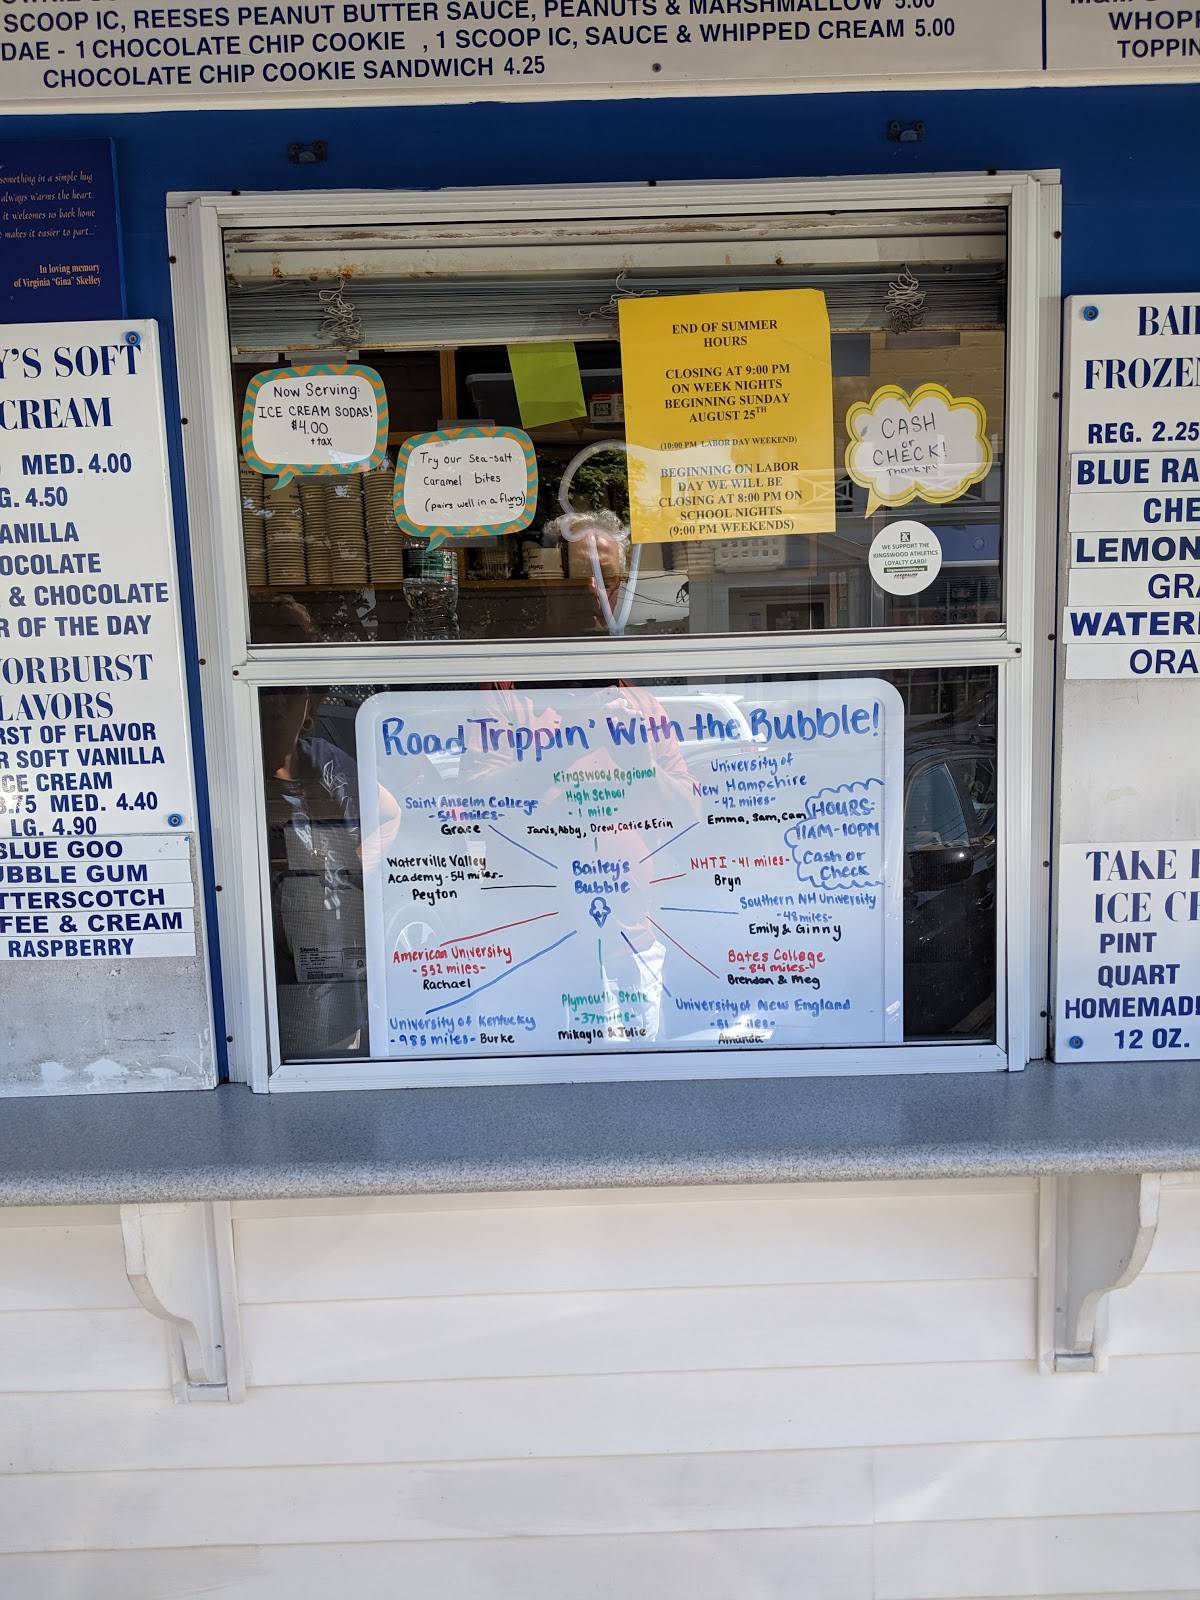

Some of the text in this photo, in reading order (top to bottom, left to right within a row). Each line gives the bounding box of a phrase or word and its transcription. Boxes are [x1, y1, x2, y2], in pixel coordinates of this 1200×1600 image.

[4, 0, 536, 33] SCOOP IC, REESES PEANUT BUTTER SAUCE,
[700, 17, 955, 42] WHIPPED CREAM 5.00
[43, 55, 545, 89] CHOCOLATE CHIP COOKIE SANDWICH 4.25
[12, 209, 46, 220] welcomes
[59, 208, 75, 218] back
[77, 207, 96, 218] home
[39, 264, 100, 274] In loving memory
[14, 278, 21, 288] of
[23, 278, 50, 289] Virginia
[76, 276, 101, 287] Skelley
[672, 319, 778, 335] END OF SUMMER
[704, 336, 748, 348] HOURS
[54, 345, 141, 378] SOFT
[665, 363, 790, 379] CLOSING AT 9:00 PM
[273, 385, 300, 399] Now
[671, 379, 783, 394] ON WEEK NIGHTS
[665, 393, 791, 409] BEGINNING SUNDAY
[257, 406, 283, 419] ICE
[689, 411, 740, 423] AUGUST
[291, 420, 329, 435] $4.00
[1087, 422, 1143, 444] REG.
[22, 452, 132, 475] MED. 4.00
[419, 451, 439, 470] Try
[756, 461, 799, 473] LABOR
[474, 471, 501, 484] bites
[1077, 458, 1150, 485] BLUE
[25, 486, 68, 508] 4.50
[477, 497, 486, 506] in
[659, 490, 802, 507] CLOSING AT 8:00 PM ON
[680, 506, 783, 521] SCHOOL NIGHTS
[669, 520, 795, 537] (9:00 PM WEEKENDS)
[34, 582, 169, 605] CHOCOLATE
[18, 615, 152, 637] OF THE DAY
[40, 722, 157, 744] OF FLAVOR
[382, 717, 467, 756] Road
[688, 713, 741, 741] the
[750, 702, 879, 743] Bubble!
[16, 746, 165, 768] SOFT VANILLA
[711, 755, 778, 775] University
[36, 772, 113, 792] CREAM
[613, 767, 656, 786] Regional
[692, 774, 807, 798] New Hampshire
[51, 791, 158, 813] MED. 4.40
[440, 796, 486, 808] Anselm
[11, 816, 97, 837] LG. 4.90
[441, 824, 481, 836] Grace
[67, 840, 123, 859] GOO
[572, 860, 630, 879] Bailey's
[691, 856, 727, 870] NHTI
[1086, 849, 1177, 881] TAKE
[87, 864, 148, 883] GUM
[575, 880, 631, 894] Bubble
[714, 874, 741, 892] Bryn
[412, 888, 458, 906] Peyton
[799, 893, 817, 904] NH
[819, 893, 876, 909] University
[1095, 892, 1151, 923] ICE
[88, 912, 183, 932] CREAM
[749, 924, 842, 942] Emily Ginny
[8, 937, 134, 958] RASPBERRY
[1100, 932, 1157, 954] PINT
[393, 946, 512, 964] American University
[728, 950, 768, 963] Bates
[423, 979, 471, 990] Rachael
[728, 974, 774, 985] Brendan
[1098, 963, 1180, 988] QUART
[676, 999, 851, 1017] University New England
[390, 1015, 536, 1033] University Kentucky
[480, 1033, 515, 1044] Burke
[1114, 1028, 1190, 1049] 12 OZ.
